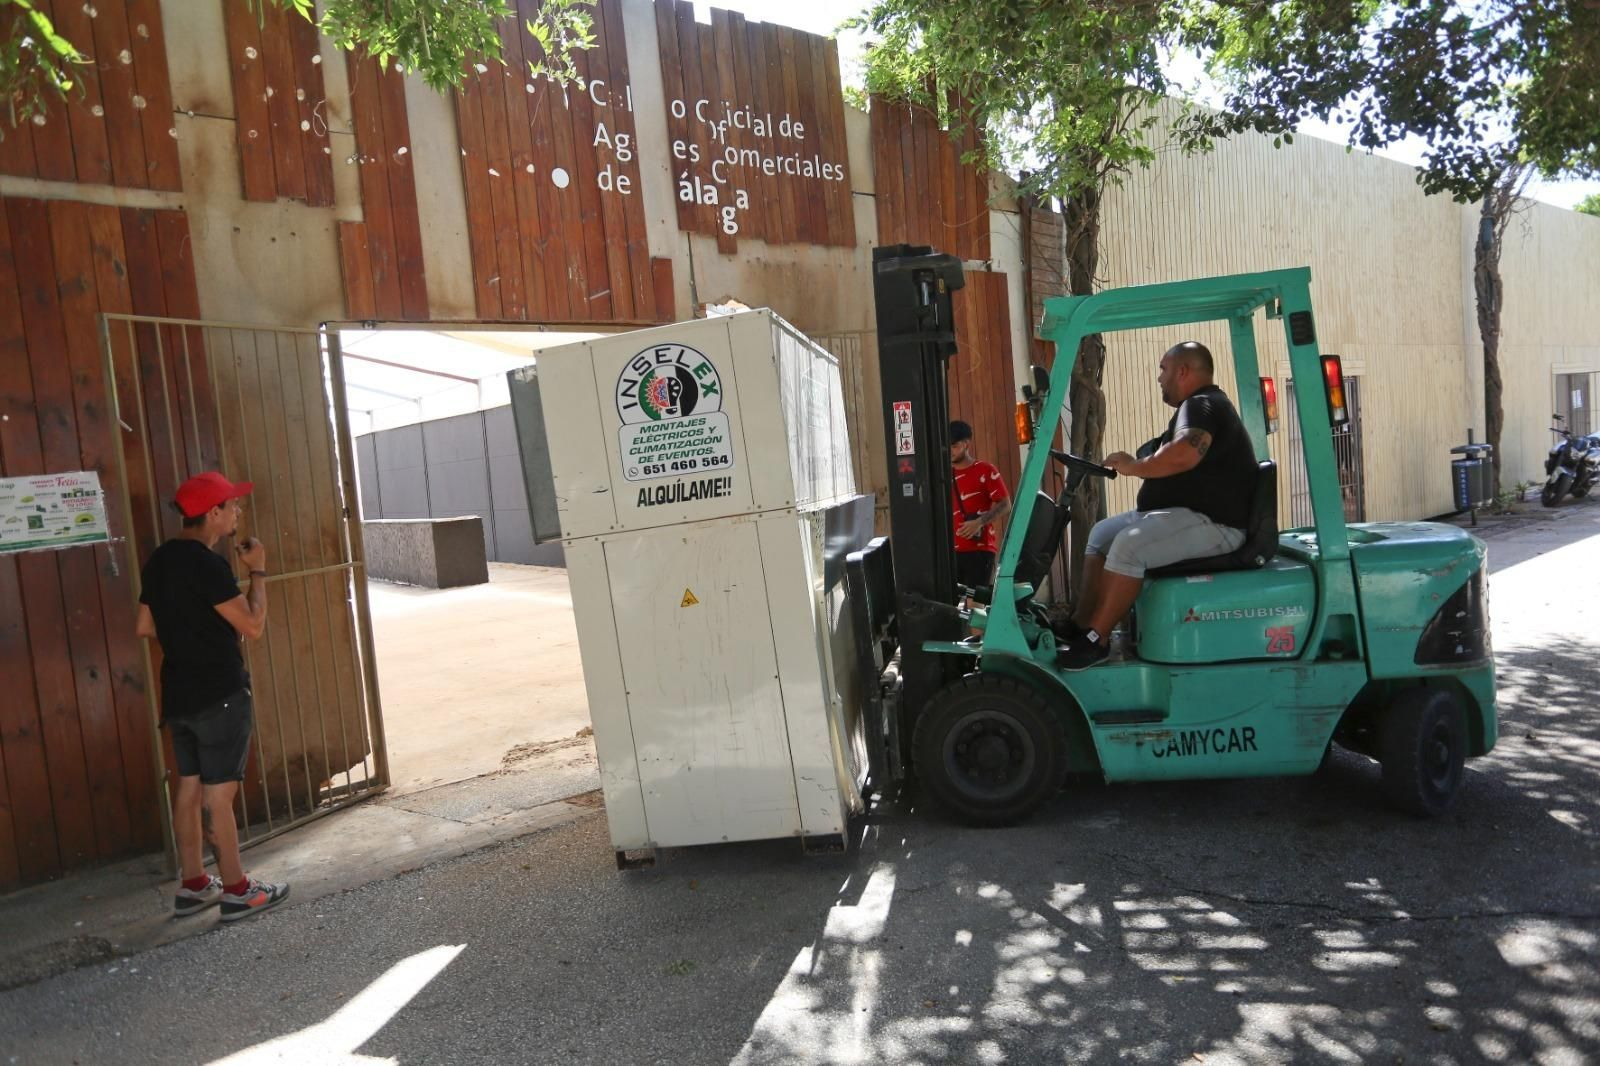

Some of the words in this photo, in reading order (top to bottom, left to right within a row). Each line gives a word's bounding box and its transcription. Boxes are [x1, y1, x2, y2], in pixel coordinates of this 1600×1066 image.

[778, 113, 805, 140] de
[711, 146, 844, 184] Comerciales
[597, 164, 632, 195] de
[620, 347, 720, 410] INSELEX
[632, 427, 704, 445] ELÉCTRICOS
[708, 425, 717, 434] Y
[639, 417, 707, 434] MONTAJES
[629, 435, 723, 456] CLIMATIZACIÓN
[637, 454, 655, 465] DE
[643, 463, 666, 475] 651
[670, 459, 697, 471] 460
[702, 454, 729, 467] 564
[636, 476, 732, 508] ALQUÍLAME!!
[1200, 605, 1306, 621] MITSUBISHI
[1264, 625, 1296, 654] 25
